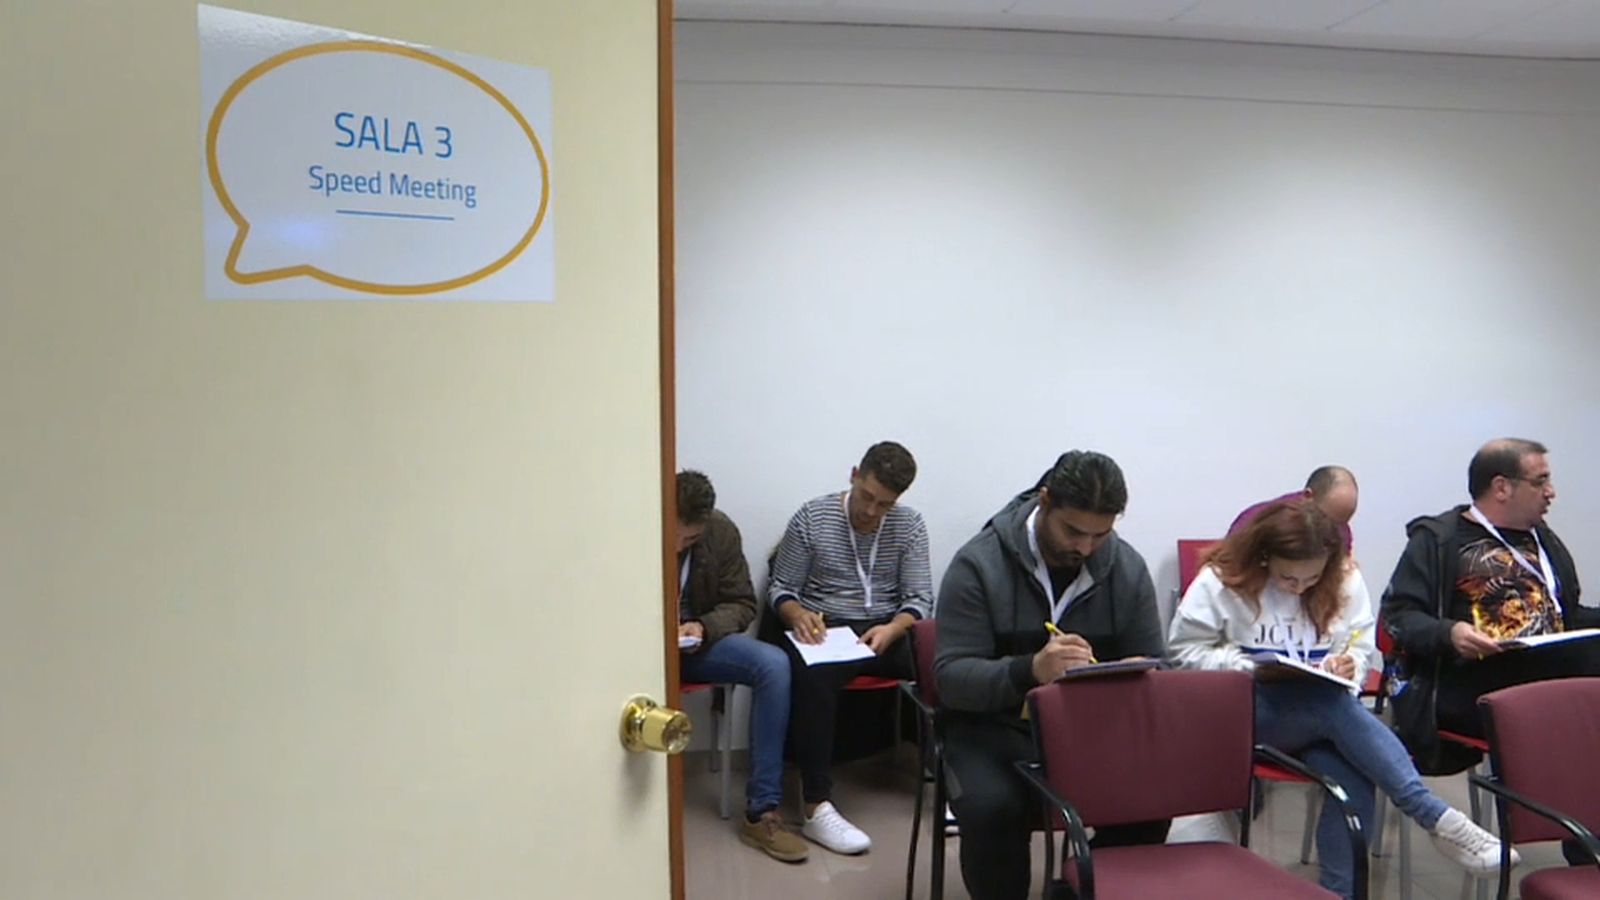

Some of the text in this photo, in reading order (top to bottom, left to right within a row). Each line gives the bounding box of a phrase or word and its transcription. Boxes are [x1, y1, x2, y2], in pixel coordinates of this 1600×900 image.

[334, 112, 453, 159] SALA 3
[308, 164, 477, 209] Speed Meeting
